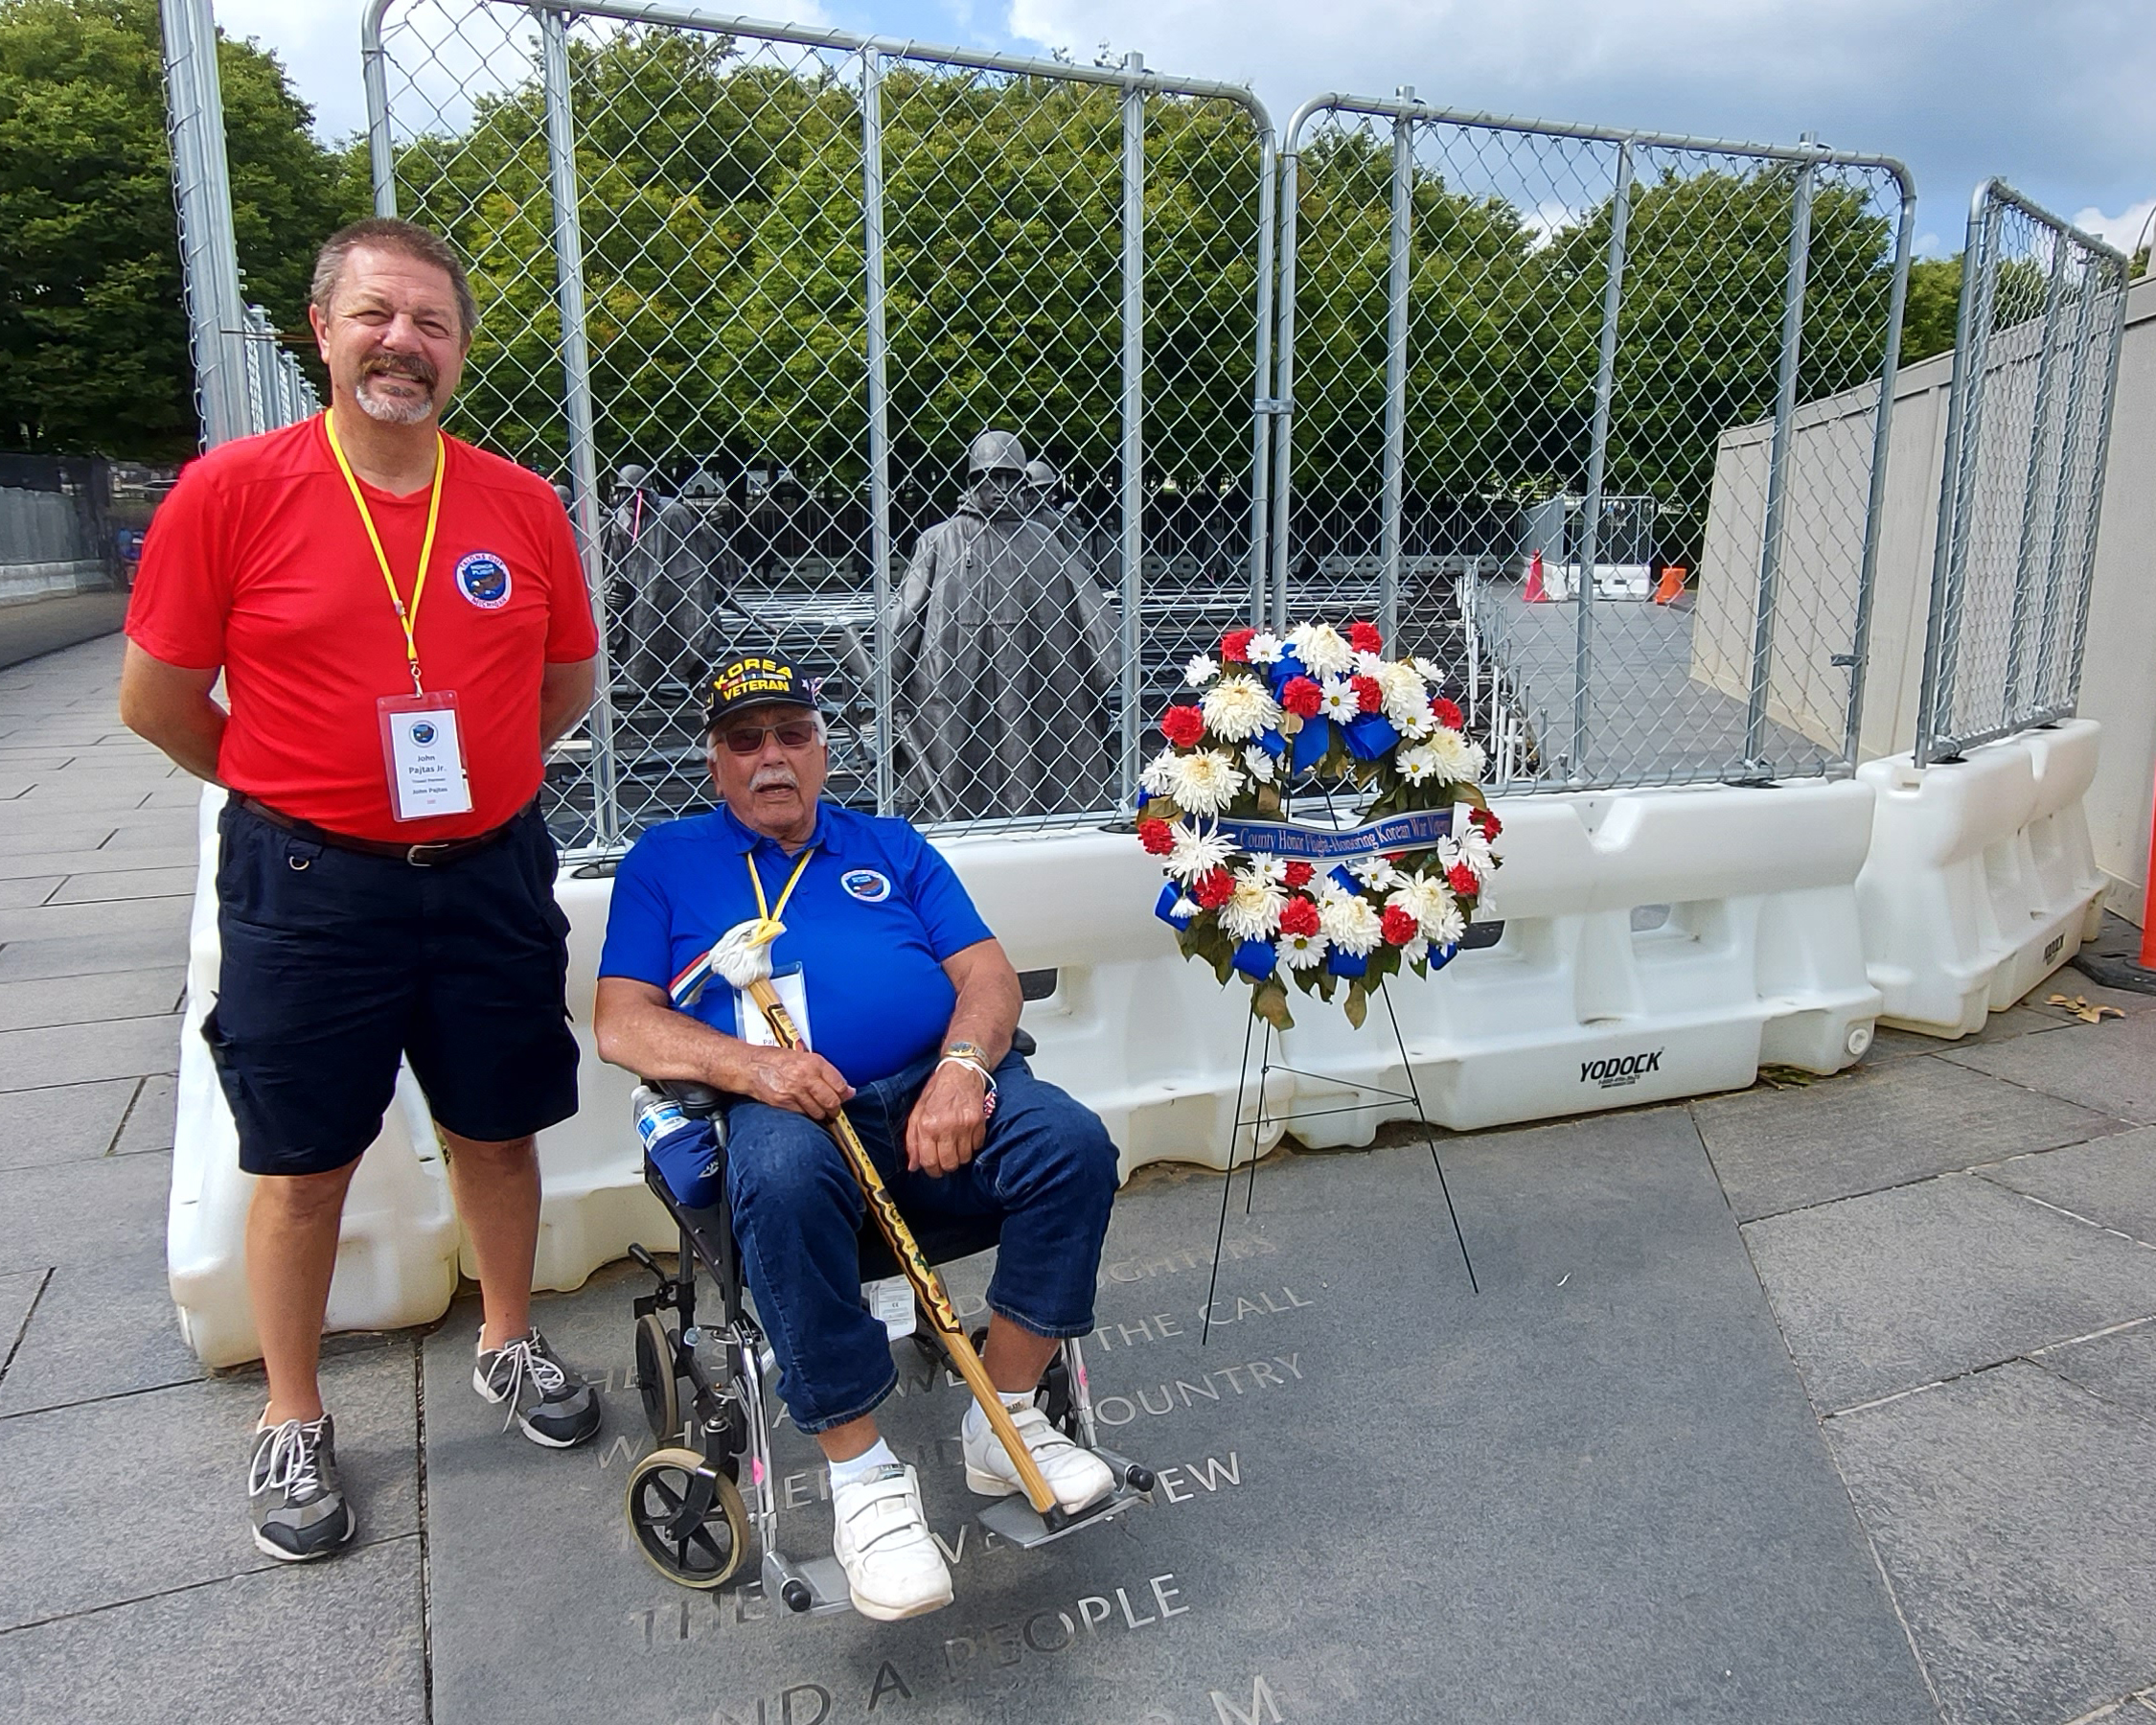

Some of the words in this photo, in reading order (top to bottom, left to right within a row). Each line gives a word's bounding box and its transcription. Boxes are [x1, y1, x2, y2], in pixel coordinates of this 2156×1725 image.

[713, 657, 793, 690] KOREA
[722, 678, 791, 701] VETERAN
[408, 766, 435, 774] Pajtas
[1239, 827, 1275, 851] County
[1277, 829, 1304, 852] Honor
[1374, 823, 1411, 843] Korean
[1580, 1050, 1663, 1083] YODOCK
[1091, 1312, 1183, 1351] THE
[1198, 1286, 1314, 1325] CALL
[1095, 1352, 1305, 1427] OUNTRY
[867, 1660, 912, 1712] A
[943, 1573, 1190, 1683] PEOPLE
